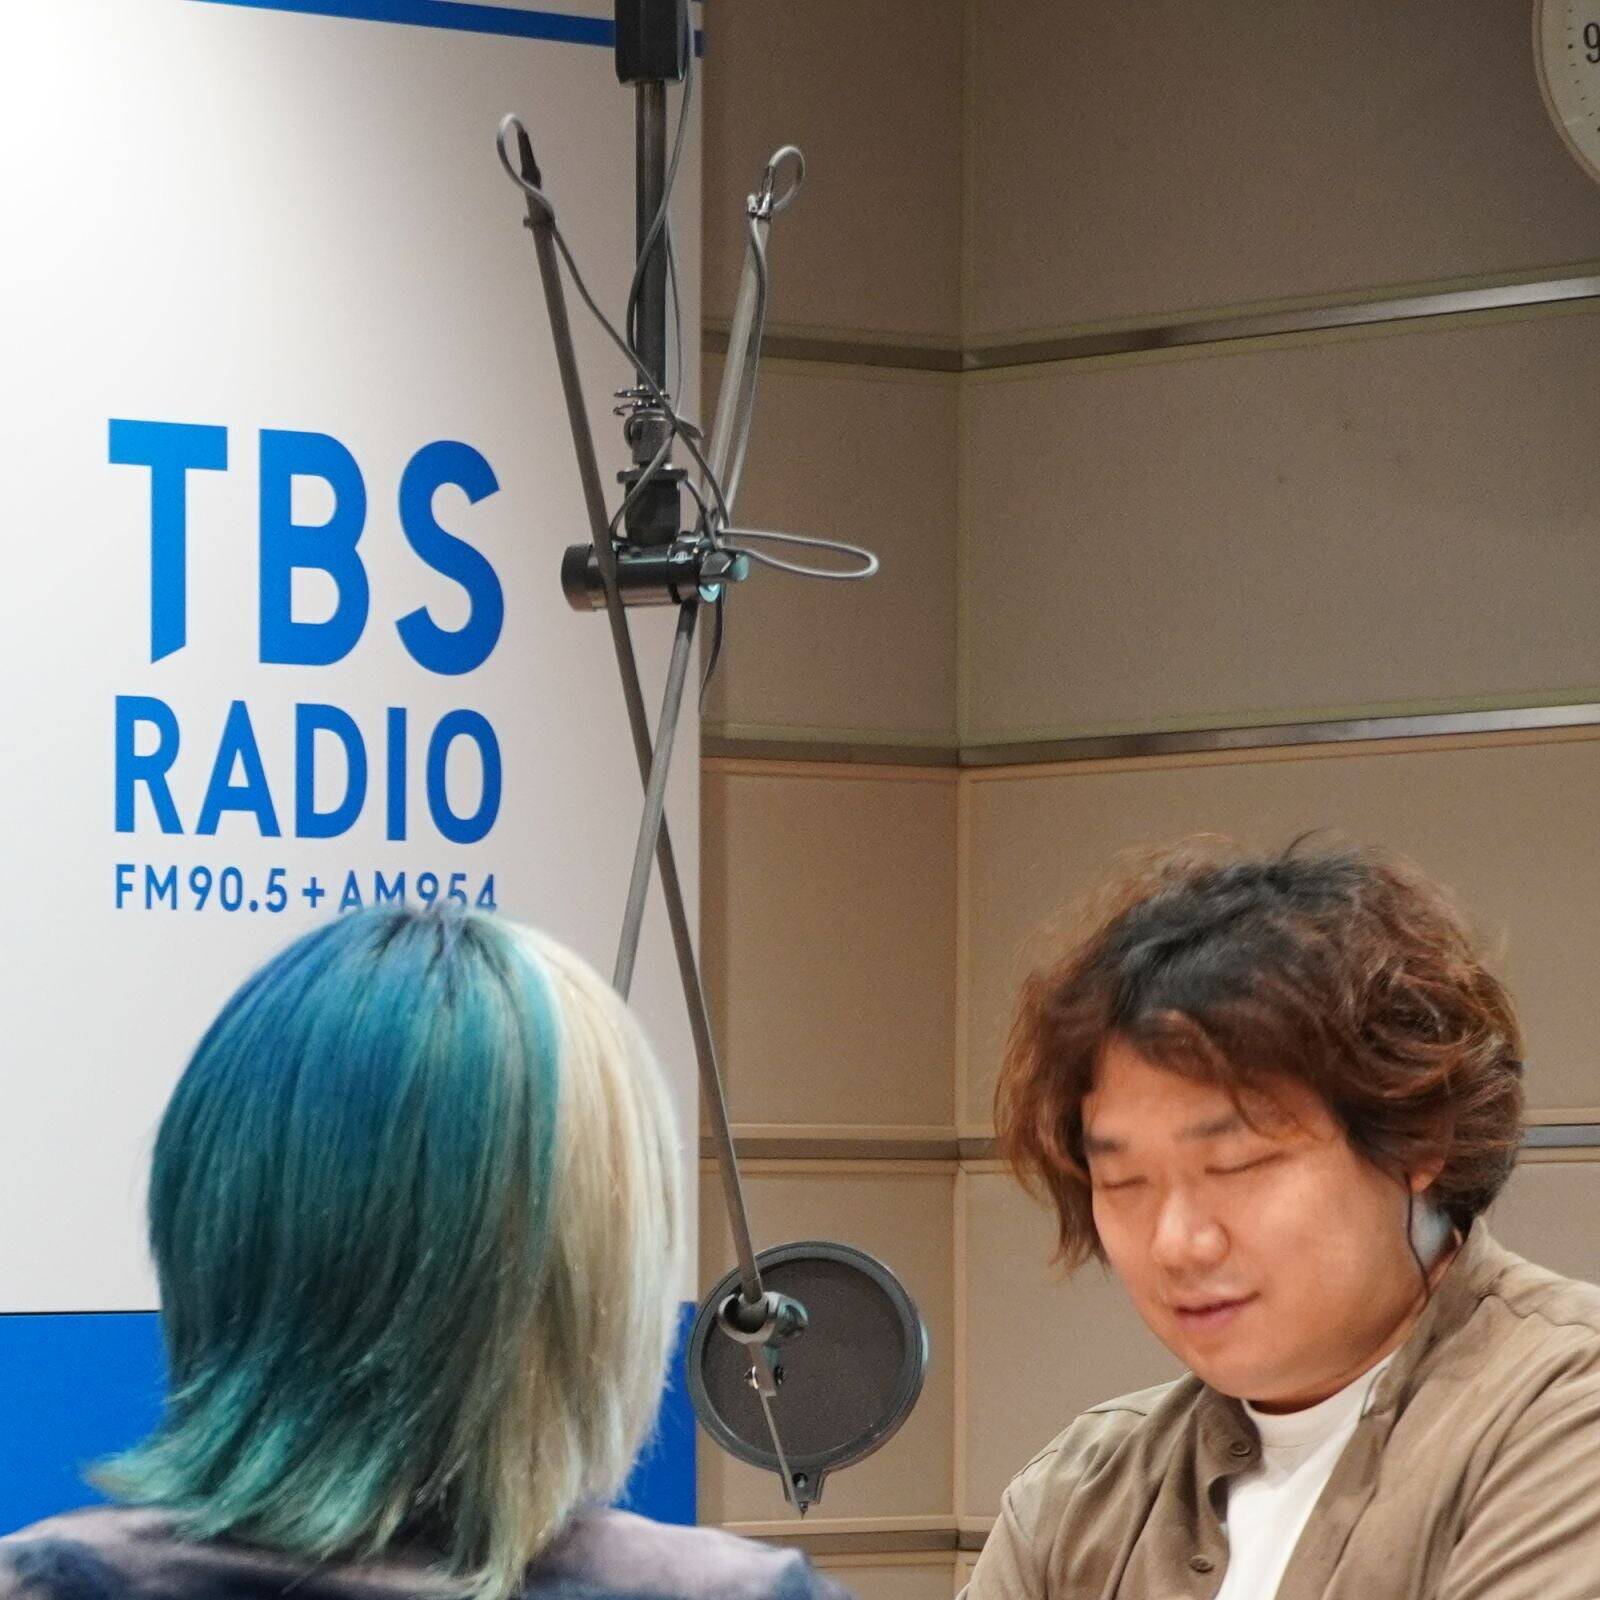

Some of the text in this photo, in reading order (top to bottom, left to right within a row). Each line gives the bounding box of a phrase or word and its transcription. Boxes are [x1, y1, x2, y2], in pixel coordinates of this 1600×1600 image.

[1583, 22, 1600, 64] 9
[108, 418, 504, 676] TBS
[115, 695, 501, 844] RADIO
